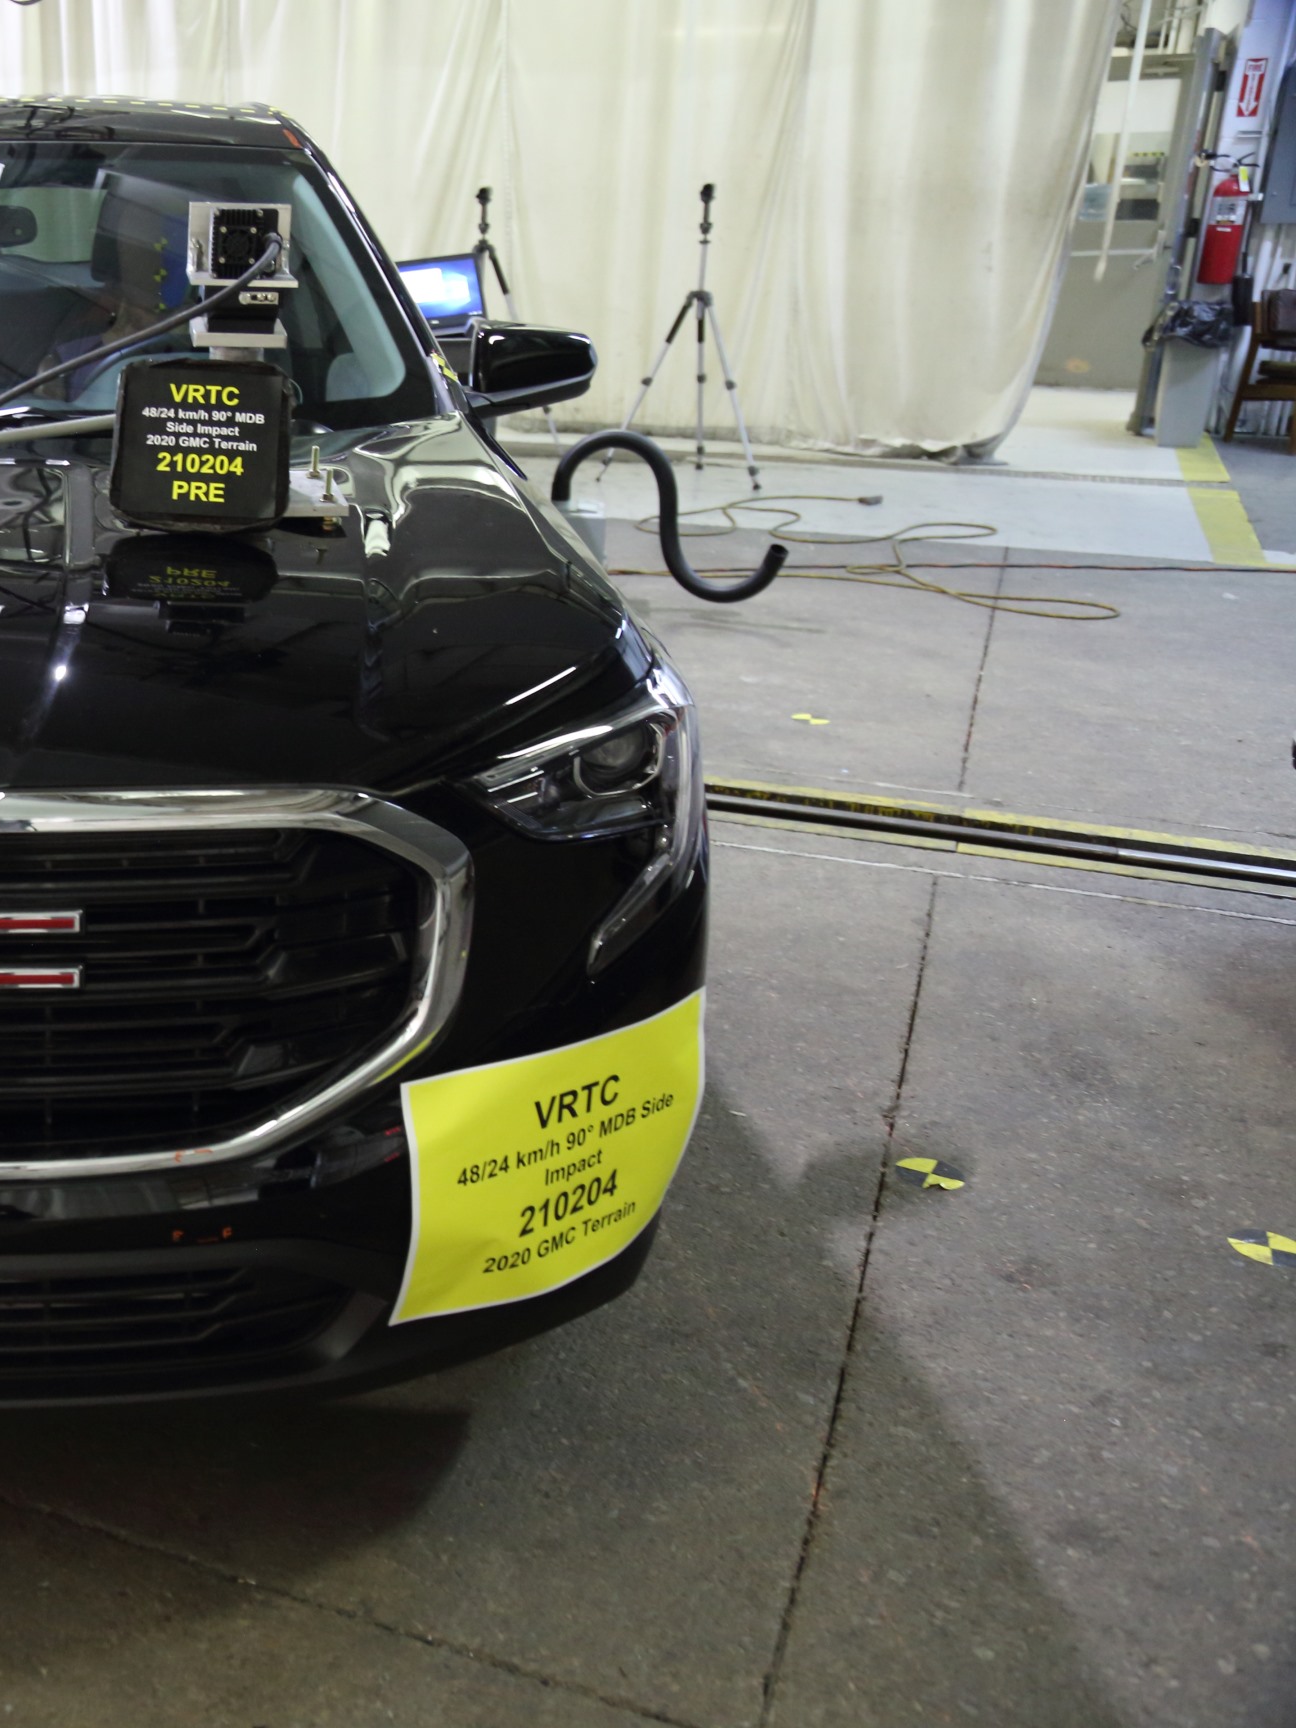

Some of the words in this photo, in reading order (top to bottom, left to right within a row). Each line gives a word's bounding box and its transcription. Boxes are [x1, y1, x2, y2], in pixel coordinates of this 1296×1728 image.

[169, 383, 240, 406] VRTC
[141, 407, 176, 418] 48/24
[178, 409, 209, 421] km/h
[211, 411, 233, 422] 90°
[235, 412, 265, 424] MDB
[166, 421, 194, 434] Side
[197, 423, 240, 437] Impact
[146, 435, 176, 447] 2020
[179, 436, 210, 449] GMC
[213, 438, 257, 452] Terrain
[156, 452, 244, 476] 210204
[171, 481, 226, 503] PRE
[534, 1074, 620, 1130] VRTC
[457, 1155, 510, 1187] 48/24
[515, 1139, 561, 1170] km/h
[565, 1123, 594, 1152] 90°
[599, 1107, 636, 1138] MDB
[640, 1092, 674, 1119] Side
[544, 1148, 603, 1186] Impact
[518, 1169, 618, 1238] 210204
[482, 1247, 531, 1274] 2020
[537, 1226, 577, 1258] GMC
[582, 1201, 636, 1237] Terrain
